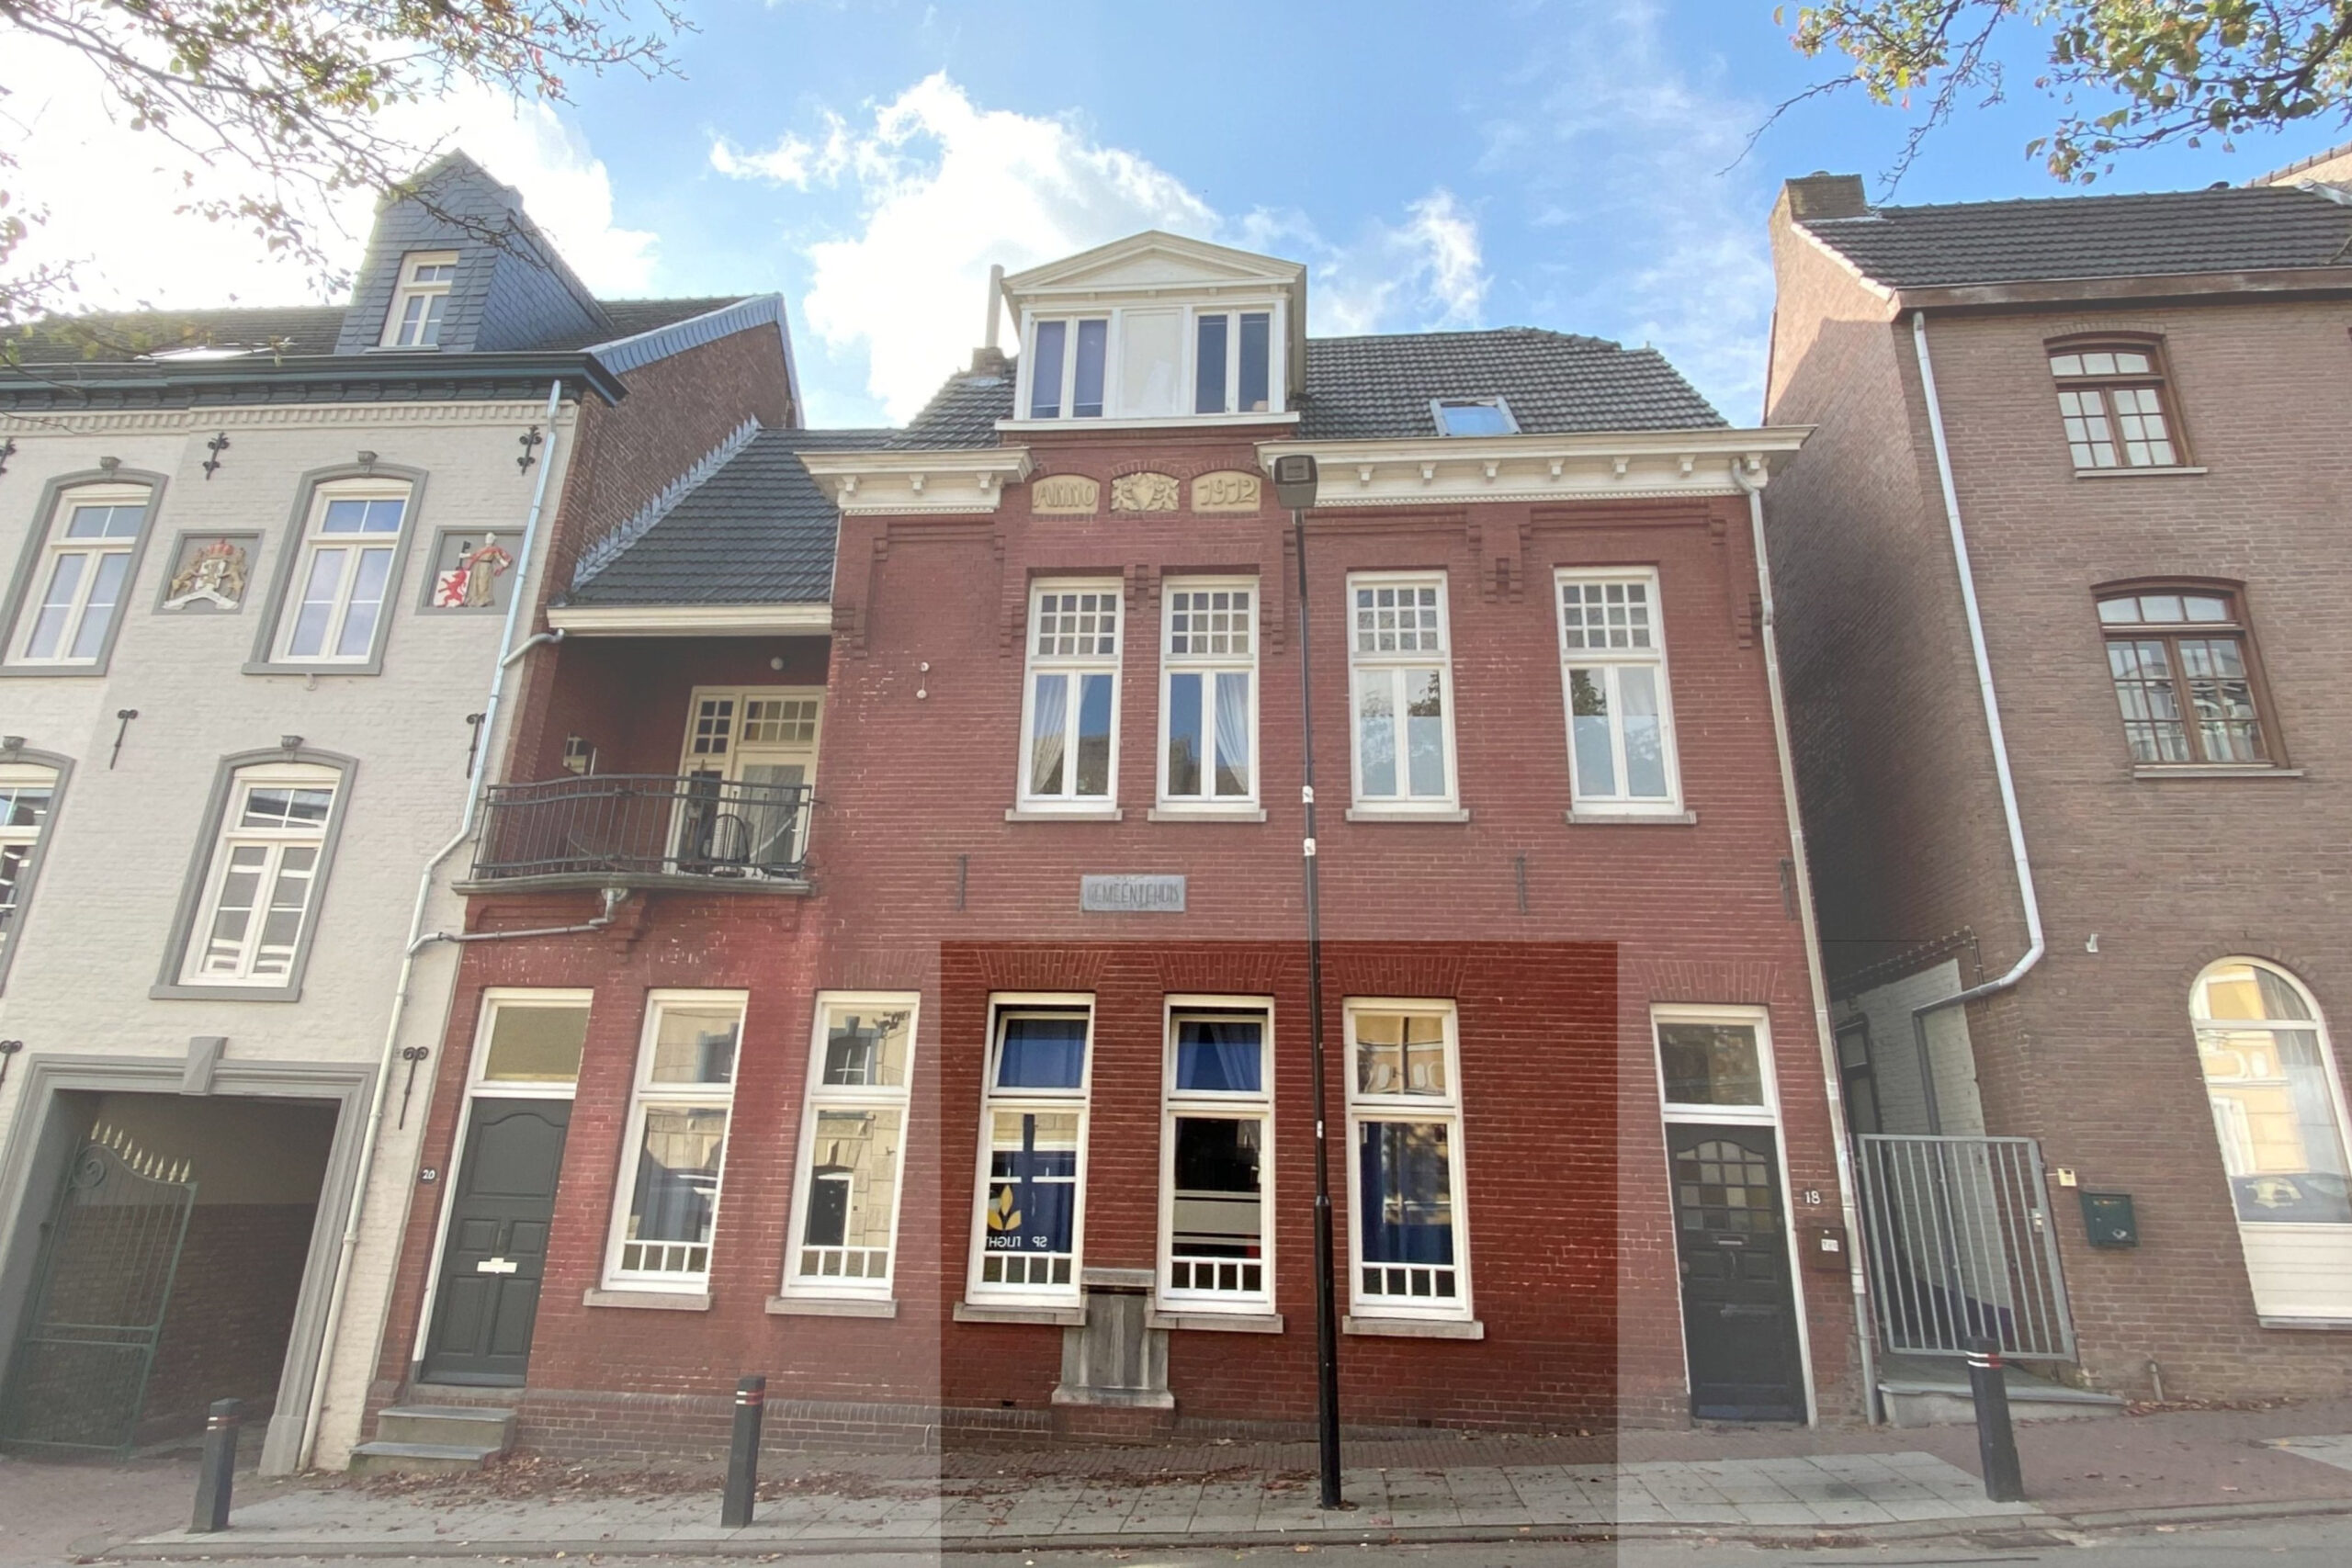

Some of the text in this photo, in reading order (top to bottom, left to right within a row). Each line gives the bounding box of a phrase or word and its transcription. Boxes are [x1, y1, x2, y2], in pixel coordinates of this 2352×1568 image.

[1033, 479, 1258, 507] ANNO 1912
[423, 1169, 435, 1179] 20
[1805, 1190, 1821, 1204] 18
